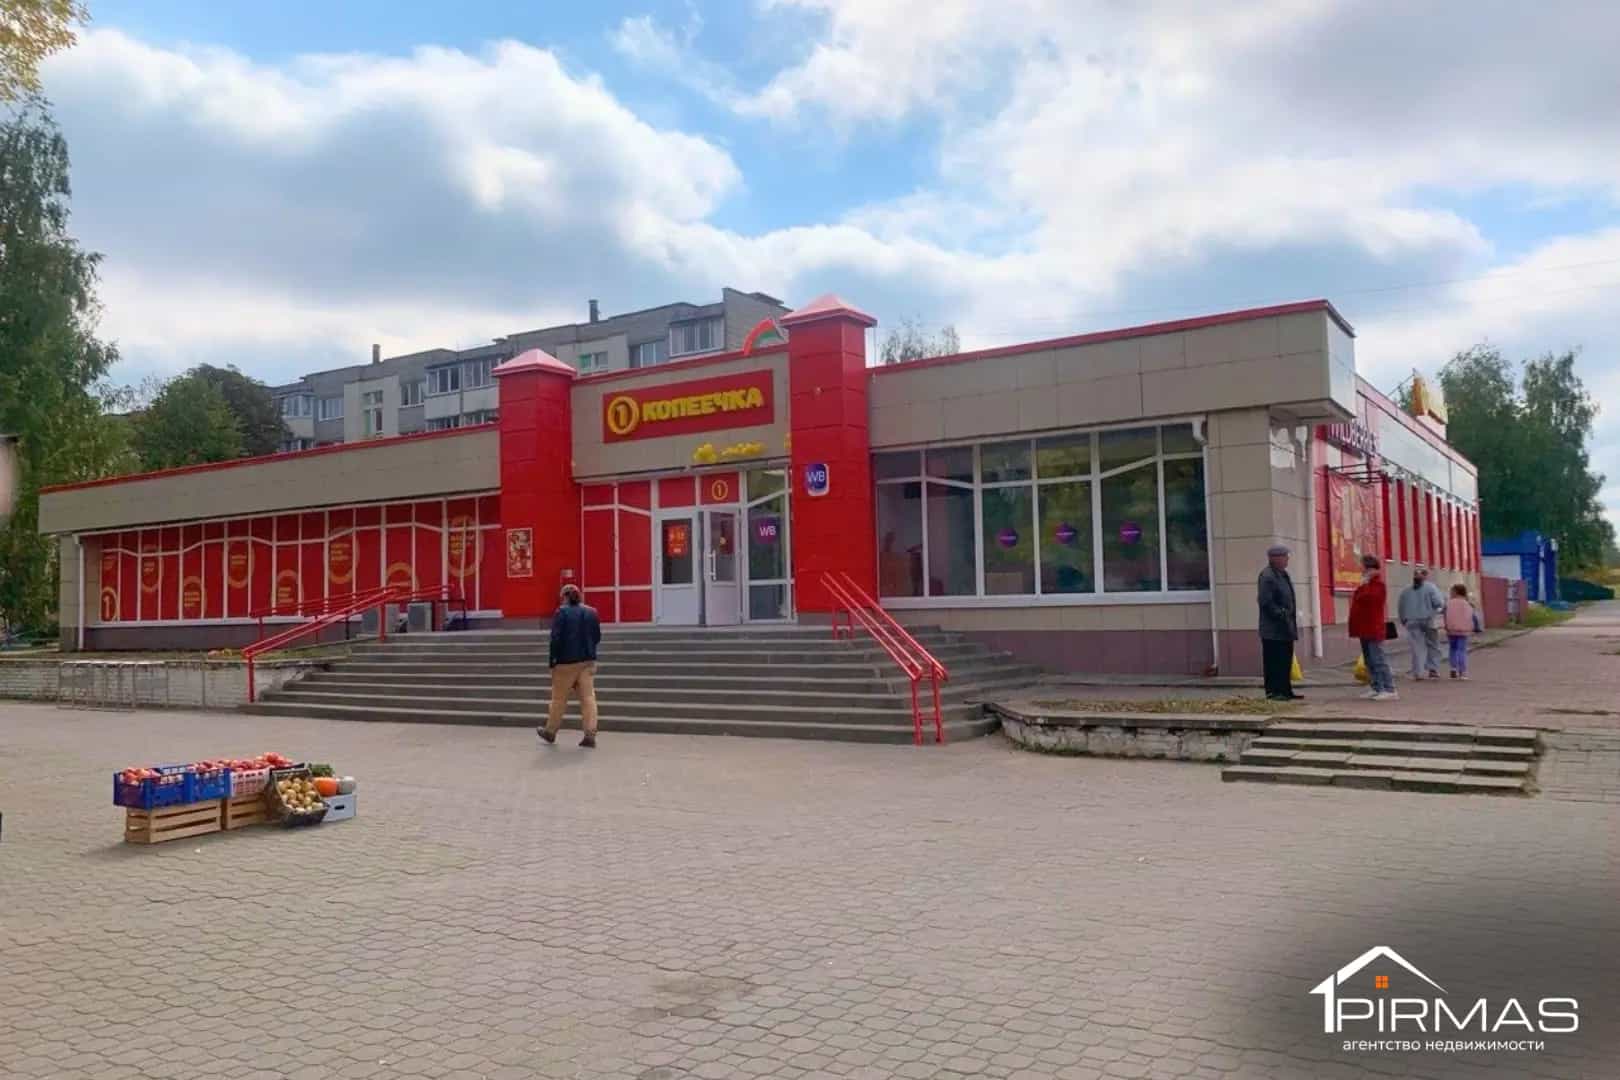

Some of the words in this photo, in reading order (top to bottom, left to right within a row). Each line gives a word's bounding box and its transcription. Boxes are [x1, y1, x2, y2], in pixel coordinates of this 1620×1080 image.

[642, 387, 764, 421] КОПЕЕЧКА
[807, 471, 826, 483] WB
[759, 525, 777, 537] WB
